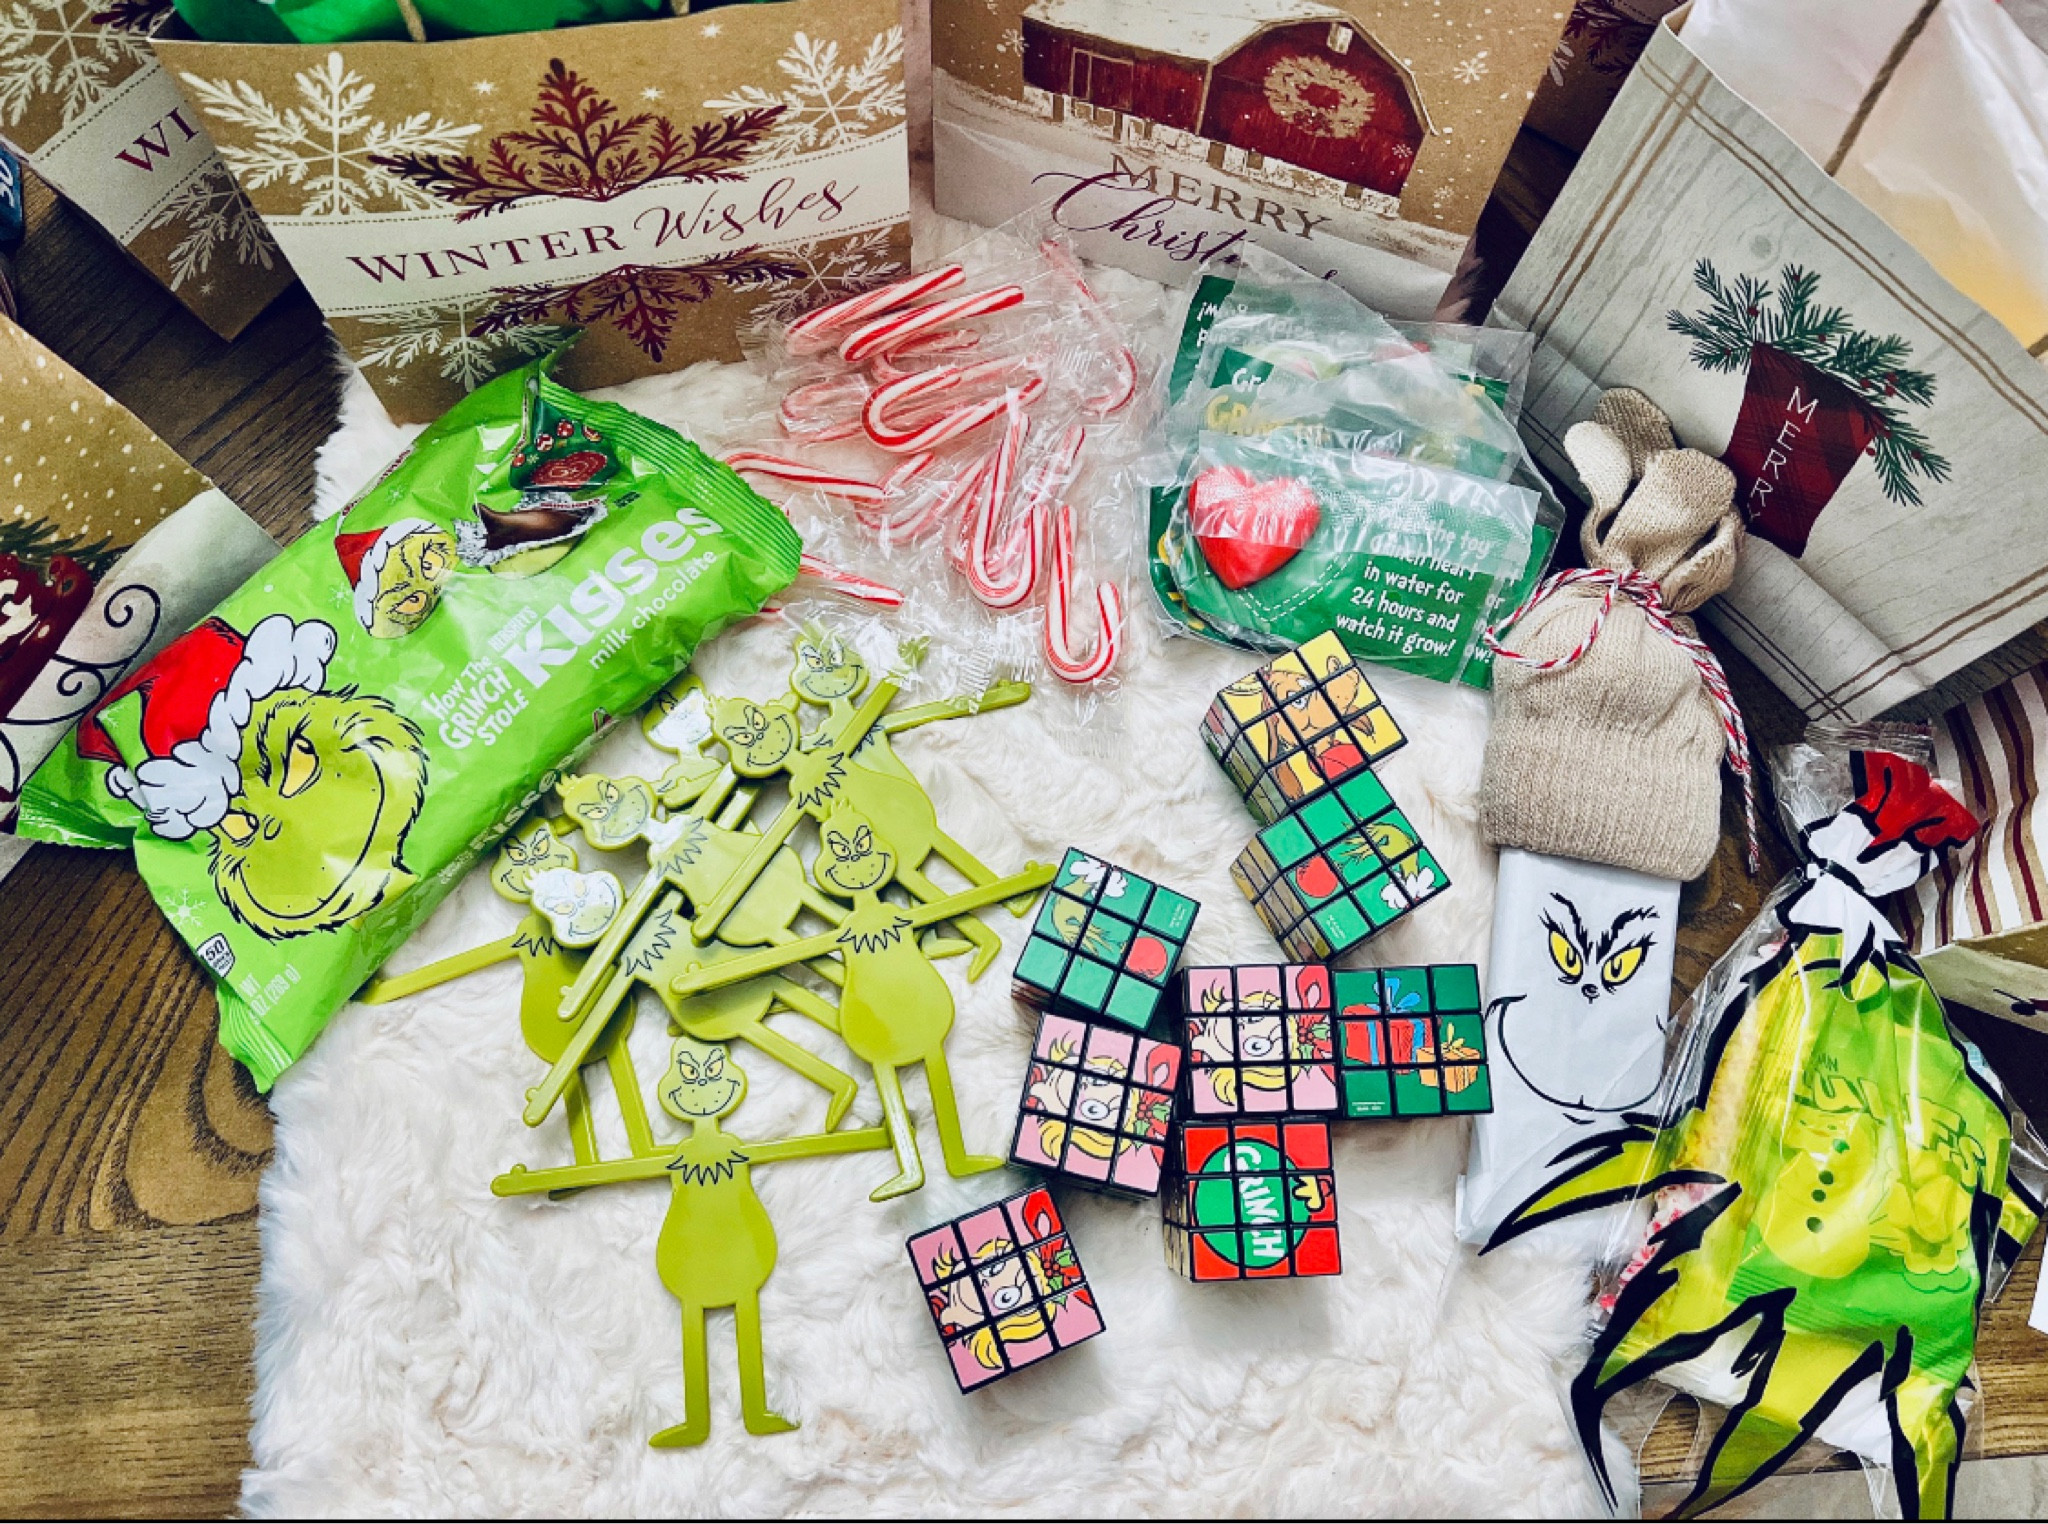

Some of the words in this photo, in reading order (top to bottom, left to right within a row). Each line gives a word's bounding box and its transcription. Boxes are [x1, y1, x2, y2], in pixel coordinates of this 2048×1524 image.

[1110, 152, 1332, 240] MERRY
[346, 224, 627, 285] WINTER
[633, 176, 859, 248] Wishes
[1460, 530, 1493, 560] toy
[588, 625, 633, 670] milk
[631, 550, 718, 630] chocolate
[1351, 586, 1375, 608] 24
[1377, 590, 1426, 622] hours
[1427, 612, 1460, 633] and
[1364, 561, 1381, 582] in
[1385, 571, 1435, 597] water
[1435, 581, 1465, 605] for
[1336, 614, 1386, 638] watch
[1387, 624, 1404, 644] it
[1402, 633, 1457, 657] grow!
[421, 679, 466, 720] How
[461, 655, 493, 683] The
[438, 665, 515, 750] GRINCH
[476, 688, 530, 746] STOLE
